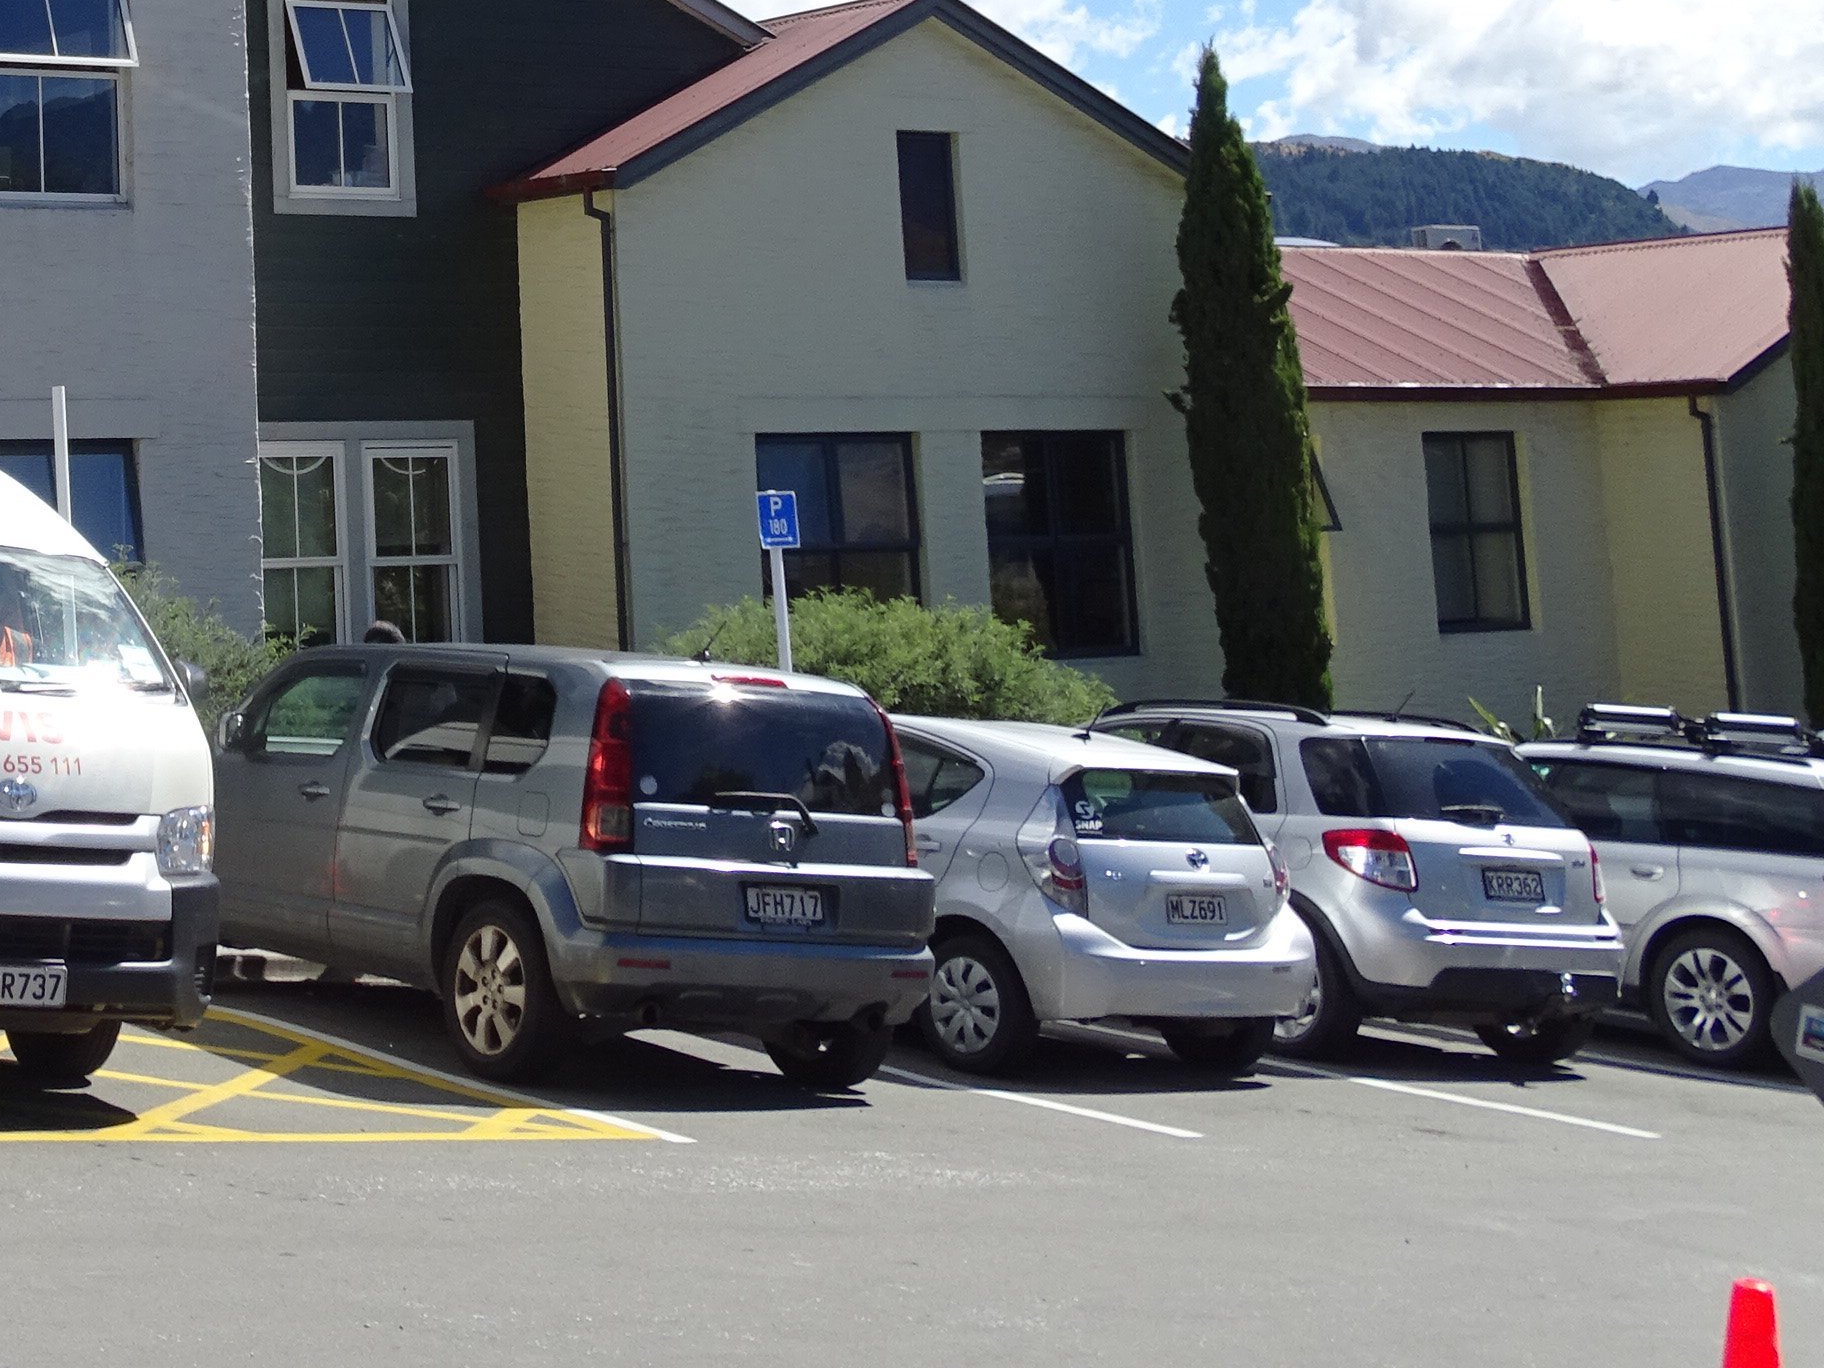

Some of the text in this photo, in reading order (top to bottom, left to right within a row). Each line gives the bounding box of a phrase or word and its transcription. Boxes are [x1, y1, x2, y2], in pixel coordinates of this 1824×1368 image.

[769, 496, 782, 517] P
[768, 518, 788, 535] 180
[3, 754, 42, 774] 655
[50, 757, 82, 776] 111
[750, 893, 819, 917] JFH717
[1170, 899, 1224, 921] MLZ691
